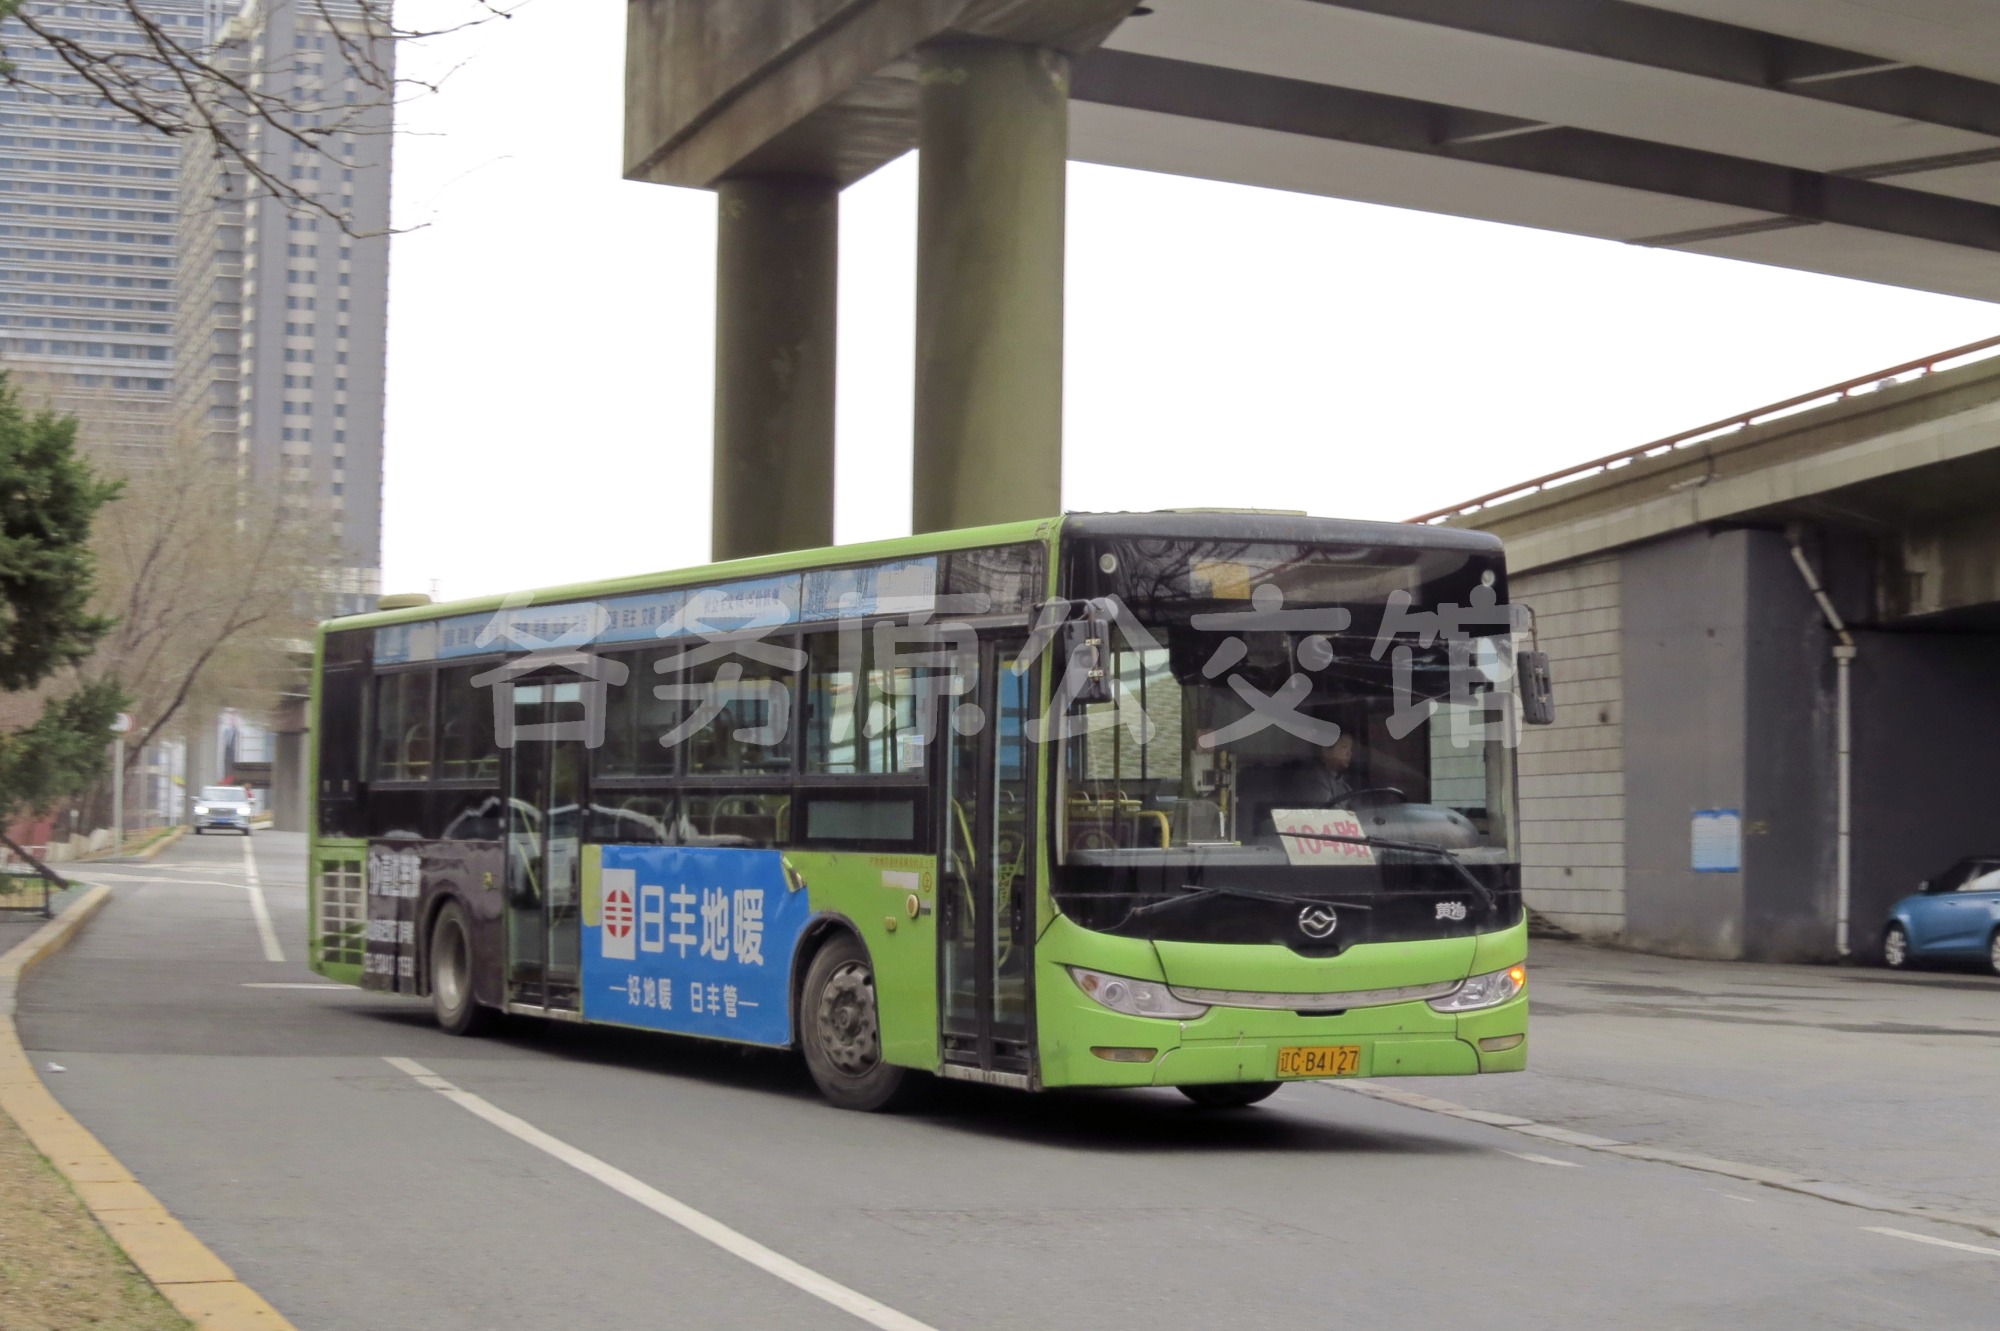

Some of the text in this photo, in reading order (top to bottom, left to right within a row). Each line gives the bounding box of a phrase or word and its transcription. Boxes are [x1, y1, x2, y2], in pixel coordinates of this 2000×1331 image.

[1286, 819, 1369, 858] 104路
[640, 884, 764, 966] 日丰地暖
